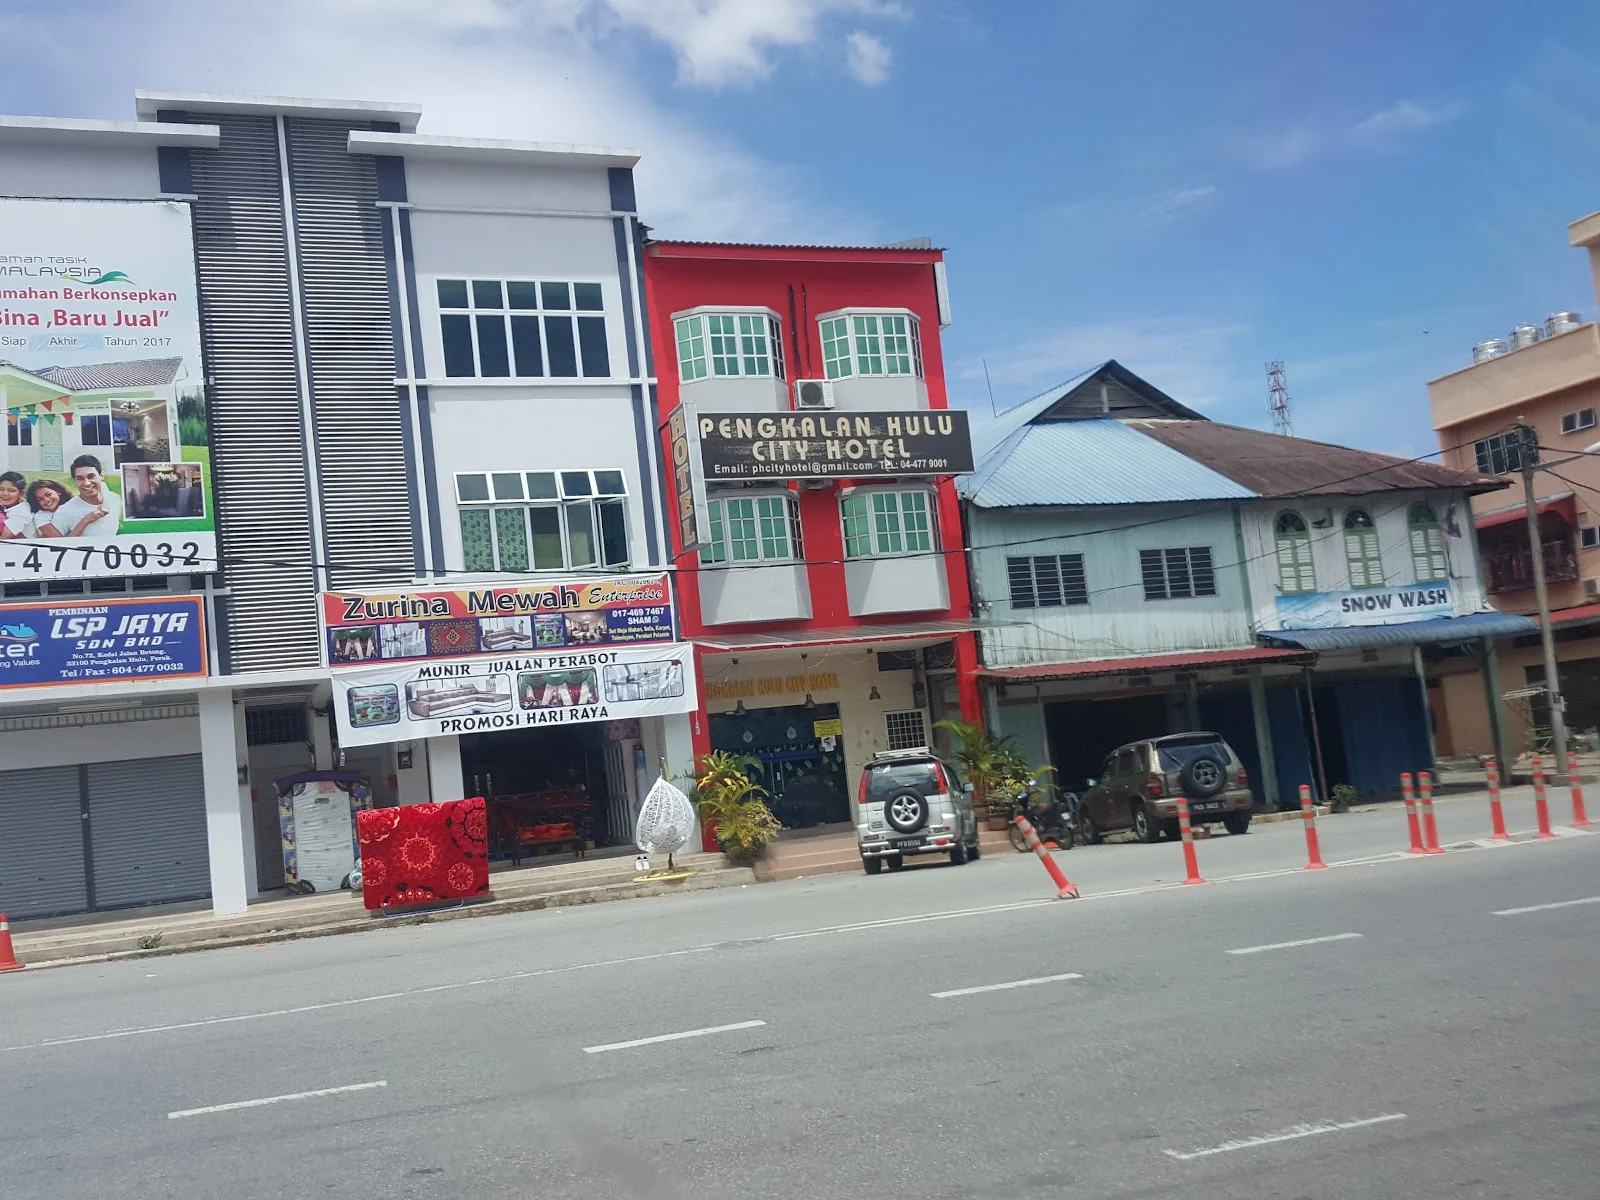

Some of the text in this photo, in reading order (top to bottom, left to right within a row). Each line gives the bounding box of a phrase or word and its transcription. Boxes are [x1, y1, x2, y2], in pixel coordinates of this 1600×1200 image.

[0, 287, 177, 303] mahan Berkonsepkan
[0, 308, 40, 326] ina
[1, 336, 171, 347] Siap Akhir Tahun 2017
[700, 415, 953, 439] PENGKALAN HULU
[752, 438, 911, 461] CITY HOTEL
[714, 463, 749, 474] Email:
[752, 461, 873, 475] phcityhotel@gmail.com
[900, 459, 927, 469] 04-477
[928, 458, 948, 468] 9001
[670, 410, 696, 547] HOTEL
[5, 541, 201, 573] -4770032
[342, 585, 663, 621] Zurina Mewah Enterprise
[1341, 588, 1448, 613] SNOW WASH
[48, 606, 109, 616] PEMBINAAN
[612, 607, 665, 618] 017-469 7467
[50, 612, 189, 639] LSP JAYA
[627, 616, 652, 625] SHAM
[75, 635, 163, 650] SDN BHD
[12, 659, 41, 668] Values
[61, 669, 77, 677] Tel
[85, 668, 105, 676] Fax
[112, 665, 155, 674] 604-477
[156, 662, 184, 672] 0032
[90, 658, 127, 666] Pengkalan
[418, 652, 618, 678] MUNIR JUALAN PERABOT
[440, 706, 609, 733] PROMOSI HARI RAYA
